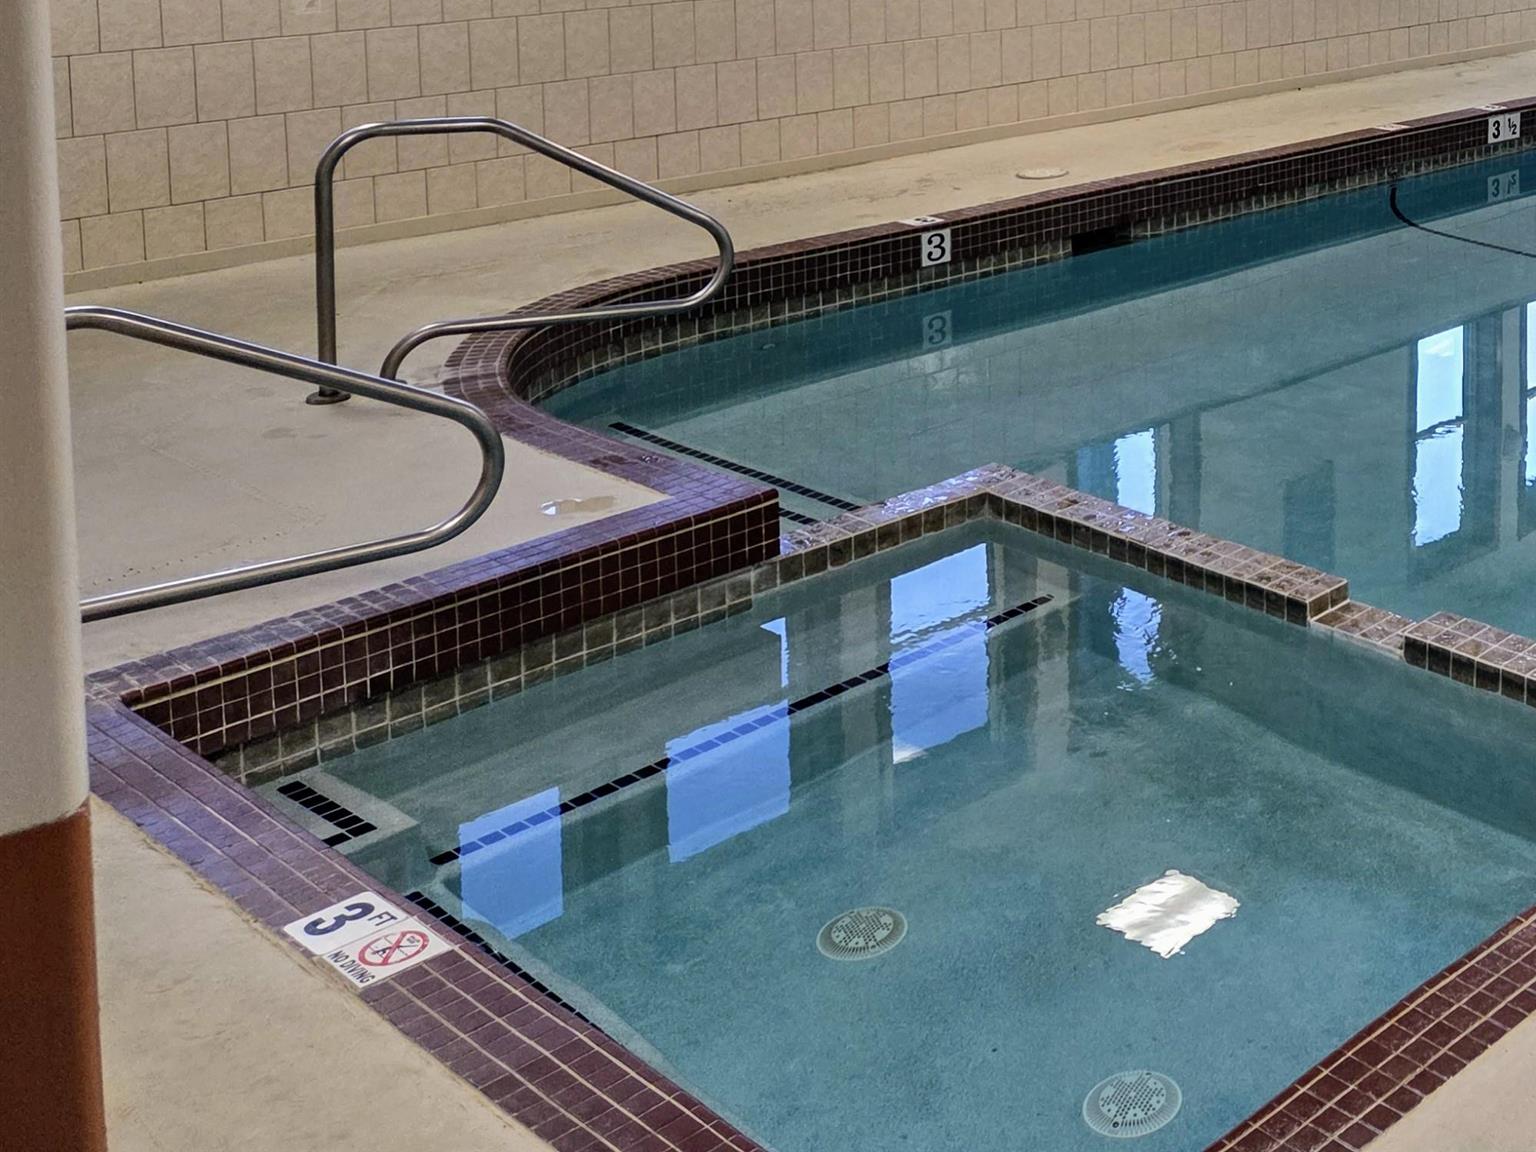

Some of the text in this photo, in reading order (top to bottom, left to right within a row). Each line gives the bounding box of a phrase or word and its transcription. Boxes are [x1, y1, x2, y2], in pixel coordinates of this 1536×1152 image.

[1492, 119, 1501, 139] 3
[927, 233, 946, 262] 3
[303, 902, 399, 936] 3 FT
[328, 950, 377, 984] NO DIVING
